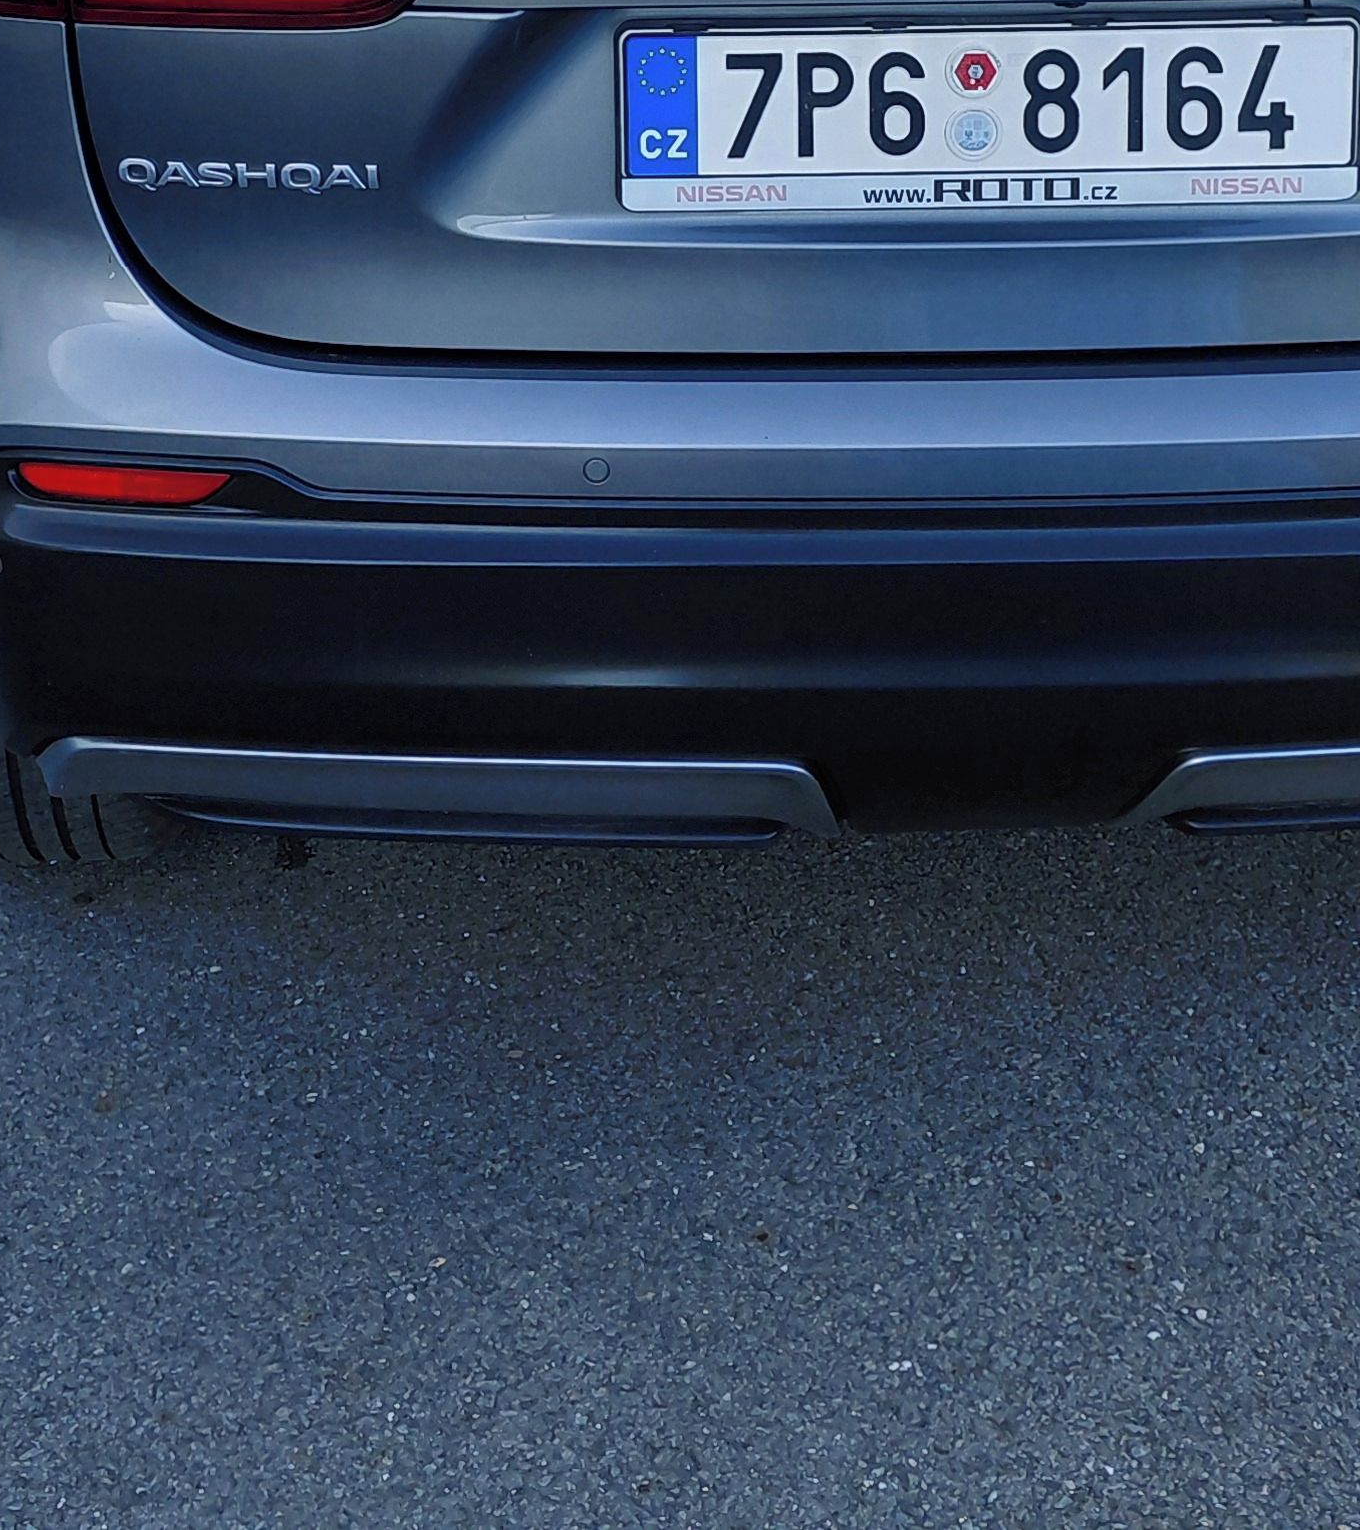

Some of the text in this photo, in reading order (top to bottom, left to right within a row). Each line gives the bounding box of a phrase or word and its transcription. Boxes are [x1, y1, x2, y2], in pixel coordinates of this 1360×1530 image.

[725, 44, 1295, 159] 7P6 8164
[639, 128, 689, 160] CZ
[117, 157, 380, 195] QASHQAI
[862, 177, 1118, 204] www.ROTO.cz
[1190, 176, 1303, 196] NISSAN
[676, 183, 788, 203] NISSAN
